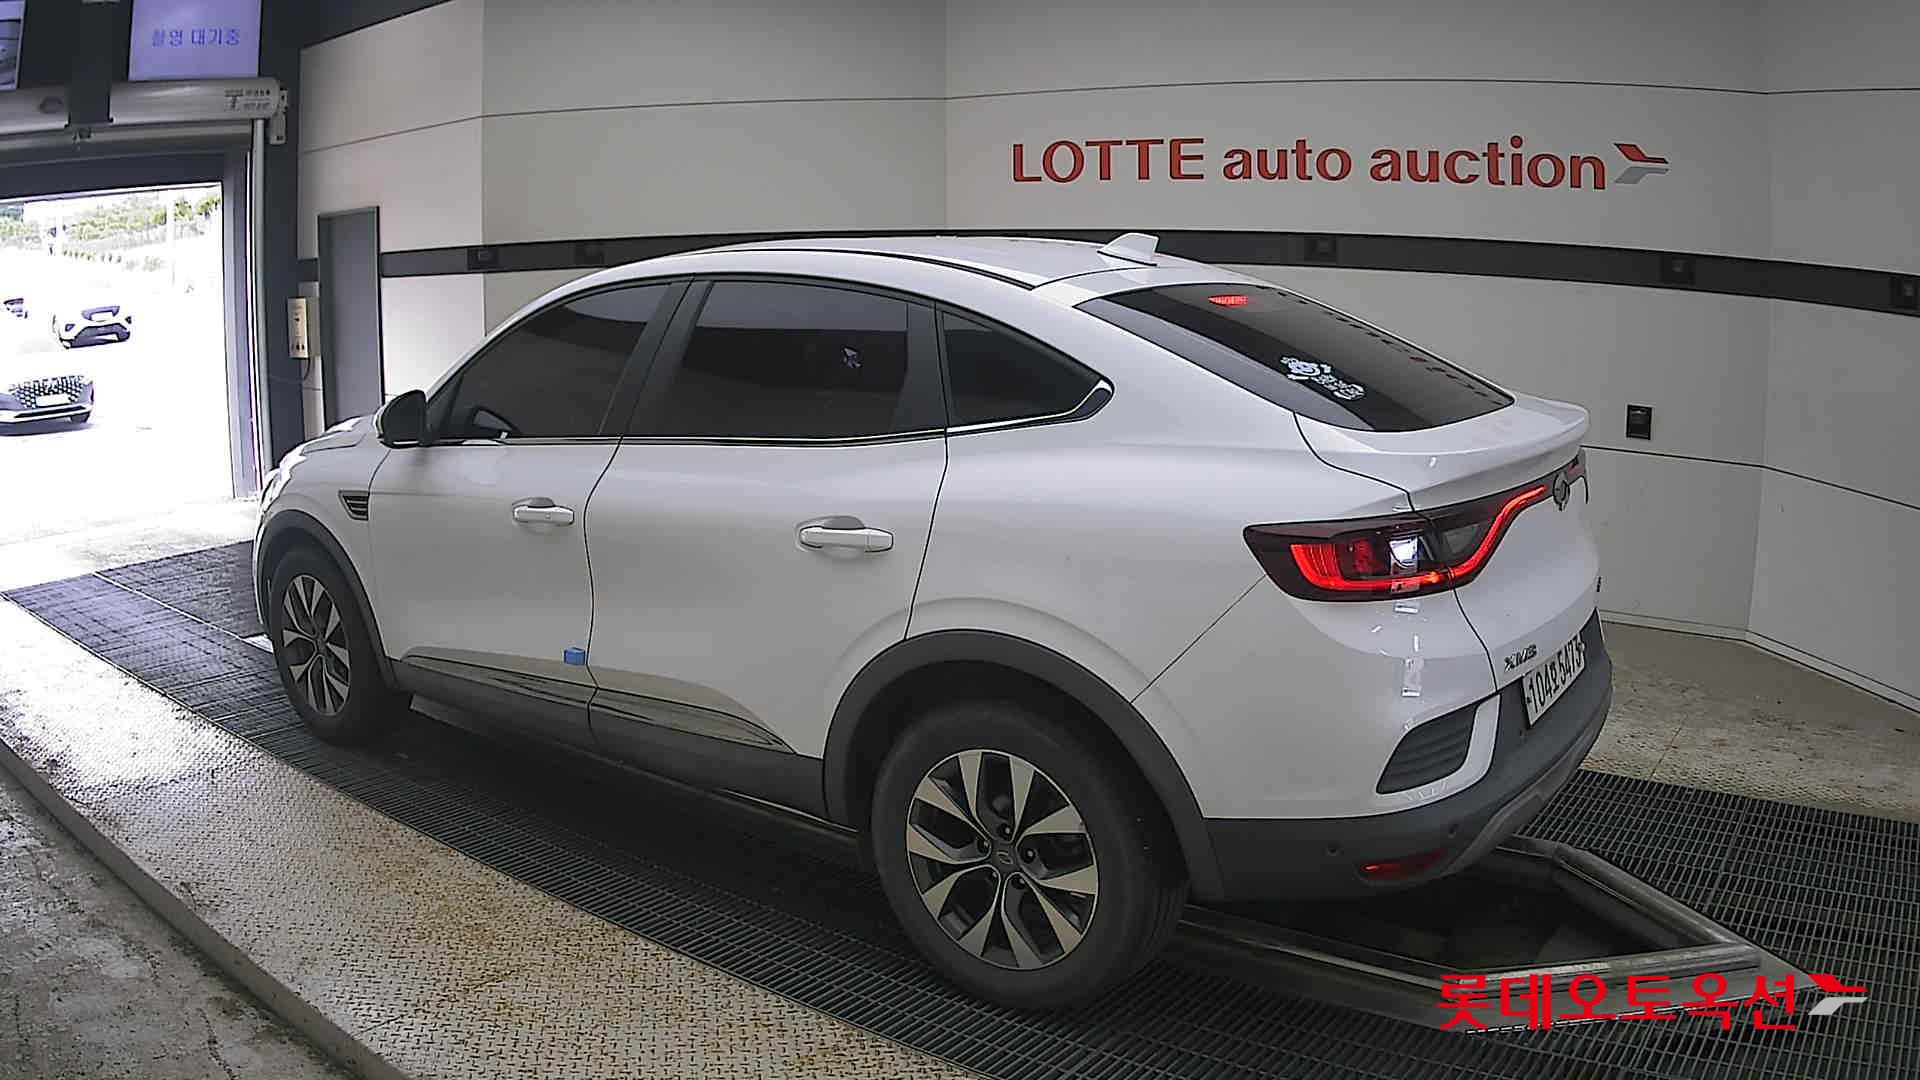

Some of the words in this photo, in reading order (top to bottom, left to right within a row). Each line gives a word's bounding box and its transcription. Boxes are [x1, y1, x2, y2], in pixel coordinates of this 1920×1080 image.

[191, 28, 241, 46] 대기중
[1012, 137, 1205, 184] LOTTE
[1223, 138, 1353, 184] auto
[1369, 135, 1607, 190] auction
